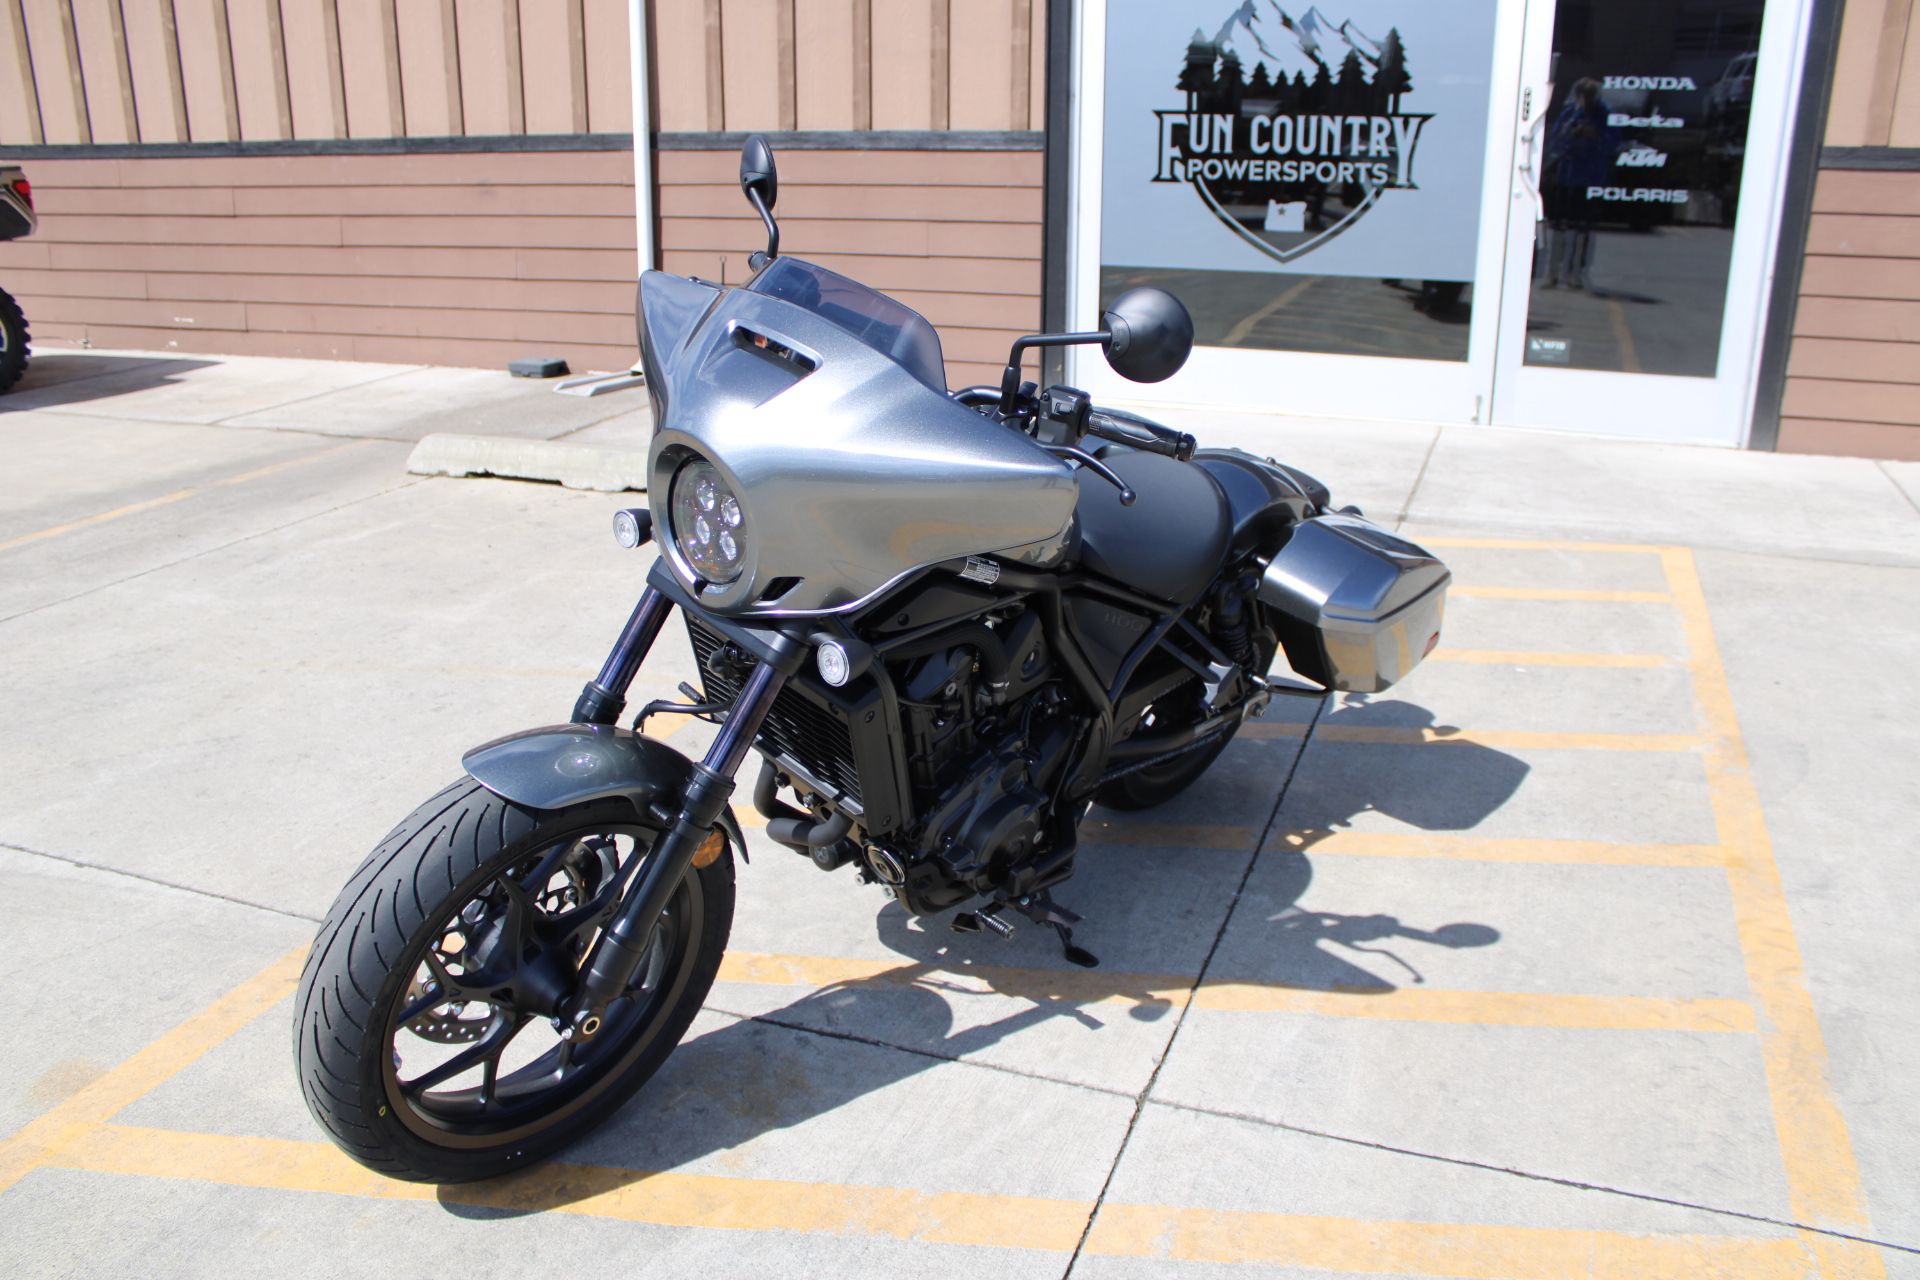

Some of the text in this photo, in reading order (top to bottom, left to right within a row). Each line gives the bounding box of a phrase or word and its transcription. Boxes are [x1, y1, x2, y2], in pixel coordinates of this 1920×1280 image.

[1603, 76, 1697, 90] HONDA
[1607, 108, 1684, 128] Beta
[1153, 111, 1429, 187] FUN COUNTRY
[1616, 148, 1667, 167] KTM
[1187, 159, 1389, 184] POWERSPORTS
[1586, 186, 1689, 203] POLARIS
